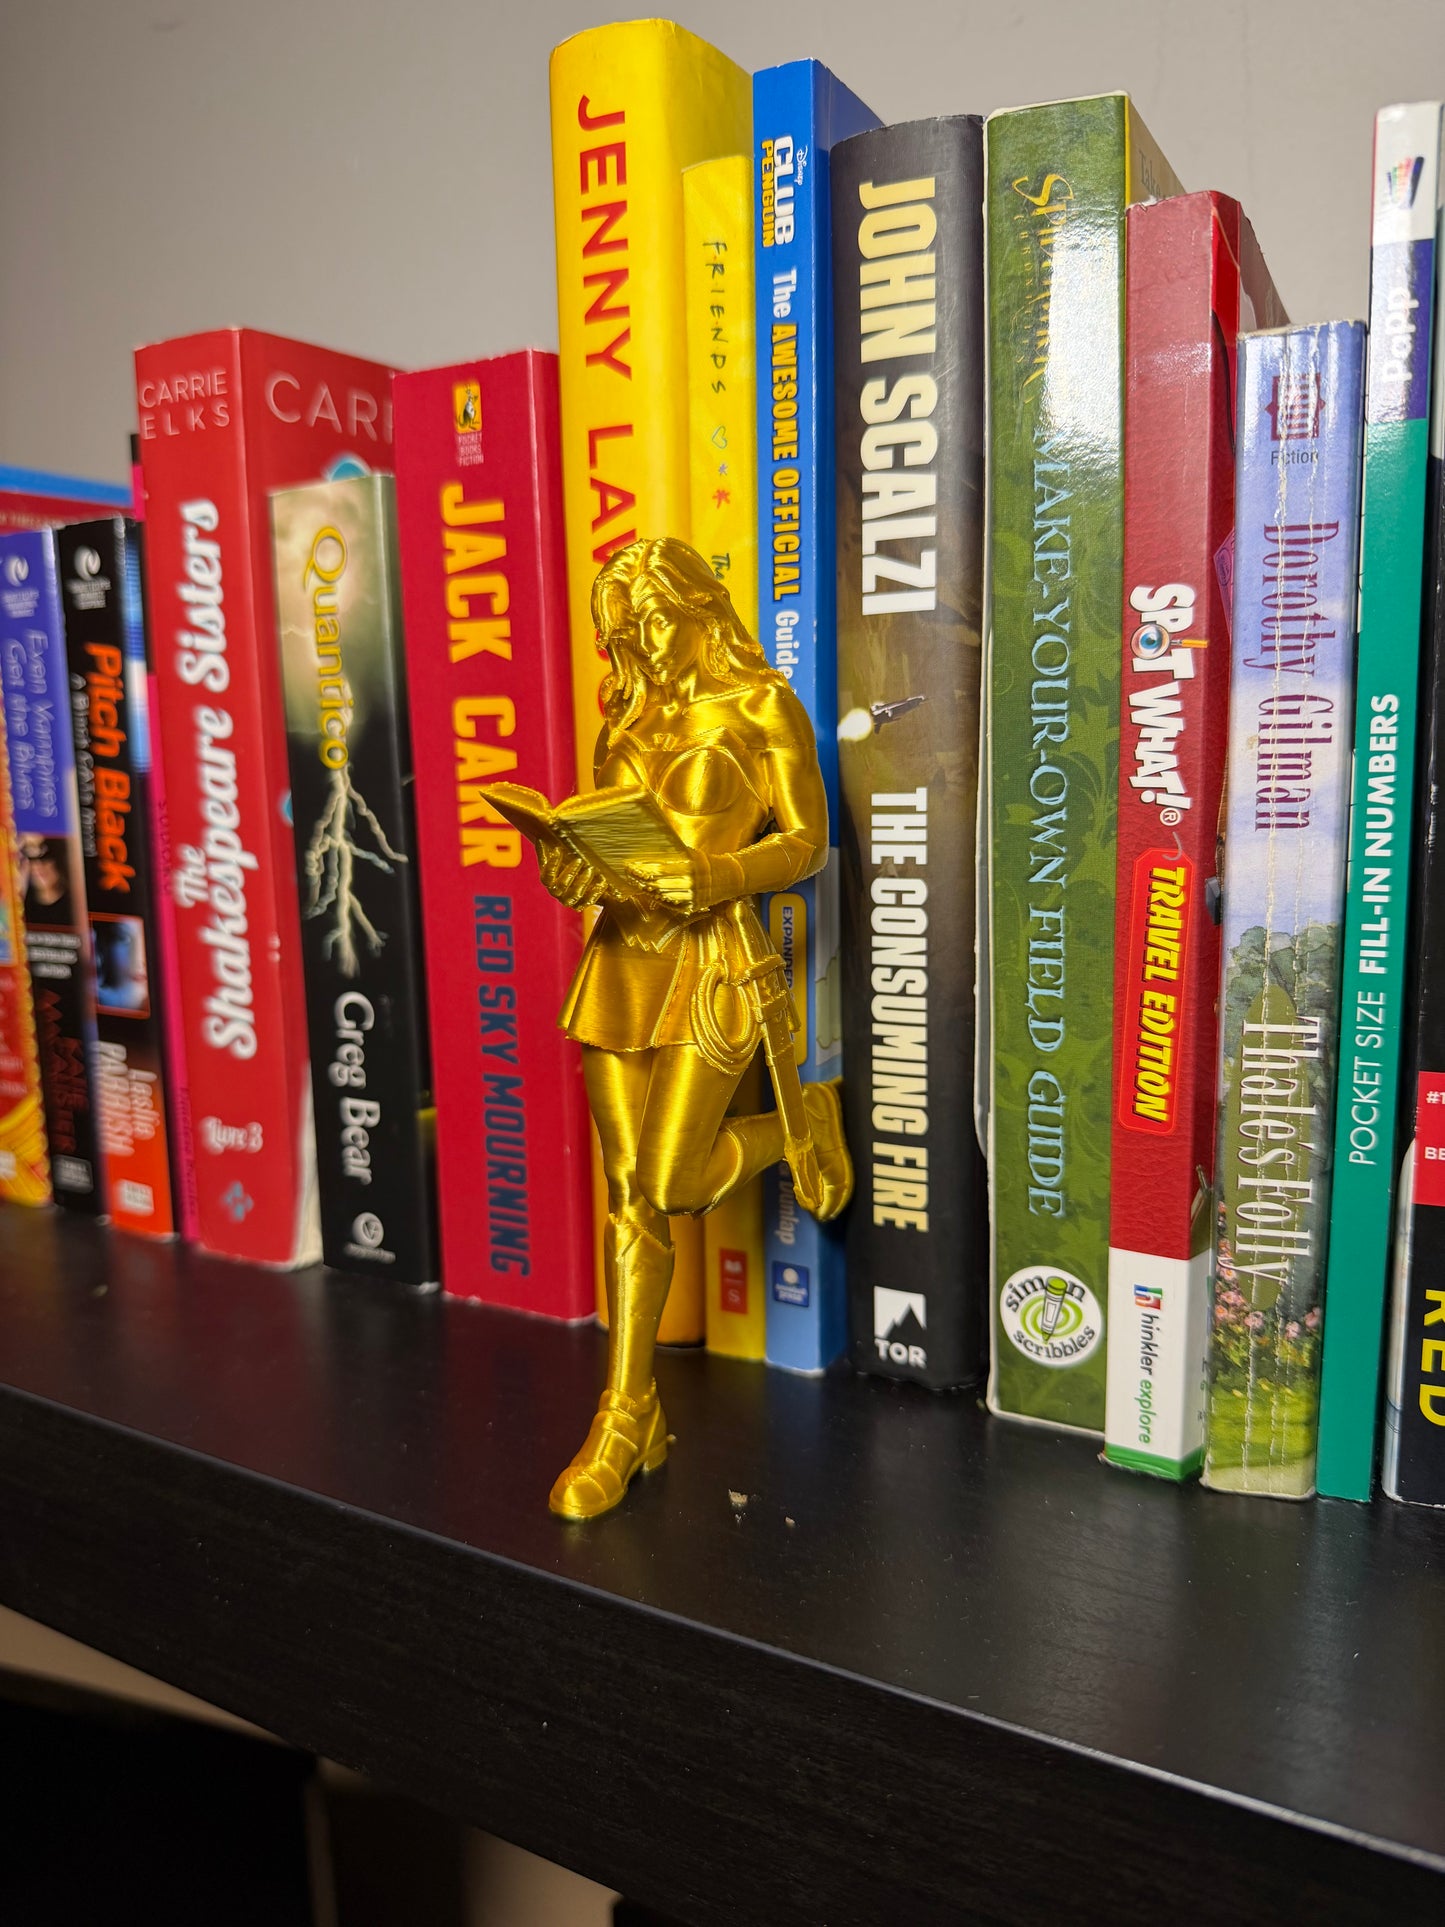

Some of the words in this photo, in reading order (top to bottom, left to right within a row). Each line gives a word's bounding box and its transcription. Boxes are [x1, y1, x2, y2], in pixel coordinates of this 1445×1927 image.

[761, 139, 775, 248] PENGUIN
[773, 136, 794, 245] CLUB
[794, 145, 808, 185] Disney
[577, 94, 632, 381] JENNY
[772, 268, 797, 319] The
[857, 176, 937, 364] JOHN
[702, 241, 729, 394] FRIENDS
[139, 367, 229, 409] CARRIE
[142, 401, 231, 440] ELKS
[265, 371, 394, 444] CAR
[771, 322, 799, 462] AWESOME
[772, 467, 801, 603] OFFICIAL
[859, 374, 938, 617] SCALZI
[177, 498, 230, 693] Sisters
[440, 478, 513, 665] JACK
[1243, 520, 1340, 677] Dorothy
[84, 641, 127, 758] Pitch
[304, 525, 354, 770] Quantico
[1254, 694, 1335, 833] Gilman
[1363, 693, 1400, 858] NUMBERS
[94, 766, 136, 894] Black
[173, 843, 209, 907] The
[193, 704, 259, 1060] Shakespeare
[871, 786, 928, 866] THE
[473, 894, 515, 975] RED
[1143, 866, 1186, 982] TRAVEL
[1359, 866, 1393, 975] FILL-IN
[478, 983, 519, 1066] SKY
[870, 877, 929, 1136] CONSUMING
[1027, 903, 1066, 1053] FIELD
[1355, 989, 1387, 1050] SIZE
[328, 990, 375, 1089] Greg
[1133, 990, 1175, 1123] EDITION
[1237, 1016, 1322, 1166] Thale's
[127, 1068, 160, 1140] Leslie
[340, 1096, 381, 1186] Bear
[1027, 1070, 1067, 1219] GUIDE
[1348, 1053, 1383, 1165] POCKET
[482, 1072, 531, 1279] MOURNING
[872, 1140, 929, 1234] FIRE
[1216, 1173, 1314, 1285] Folly
[874, 1337, 928, 1370] TOR
[1012, 1325, 1096, 1360] scribbles
[1139, 1312, 1161, 1376] hinkler
[1134, 1378, 1158, 1445] explore
